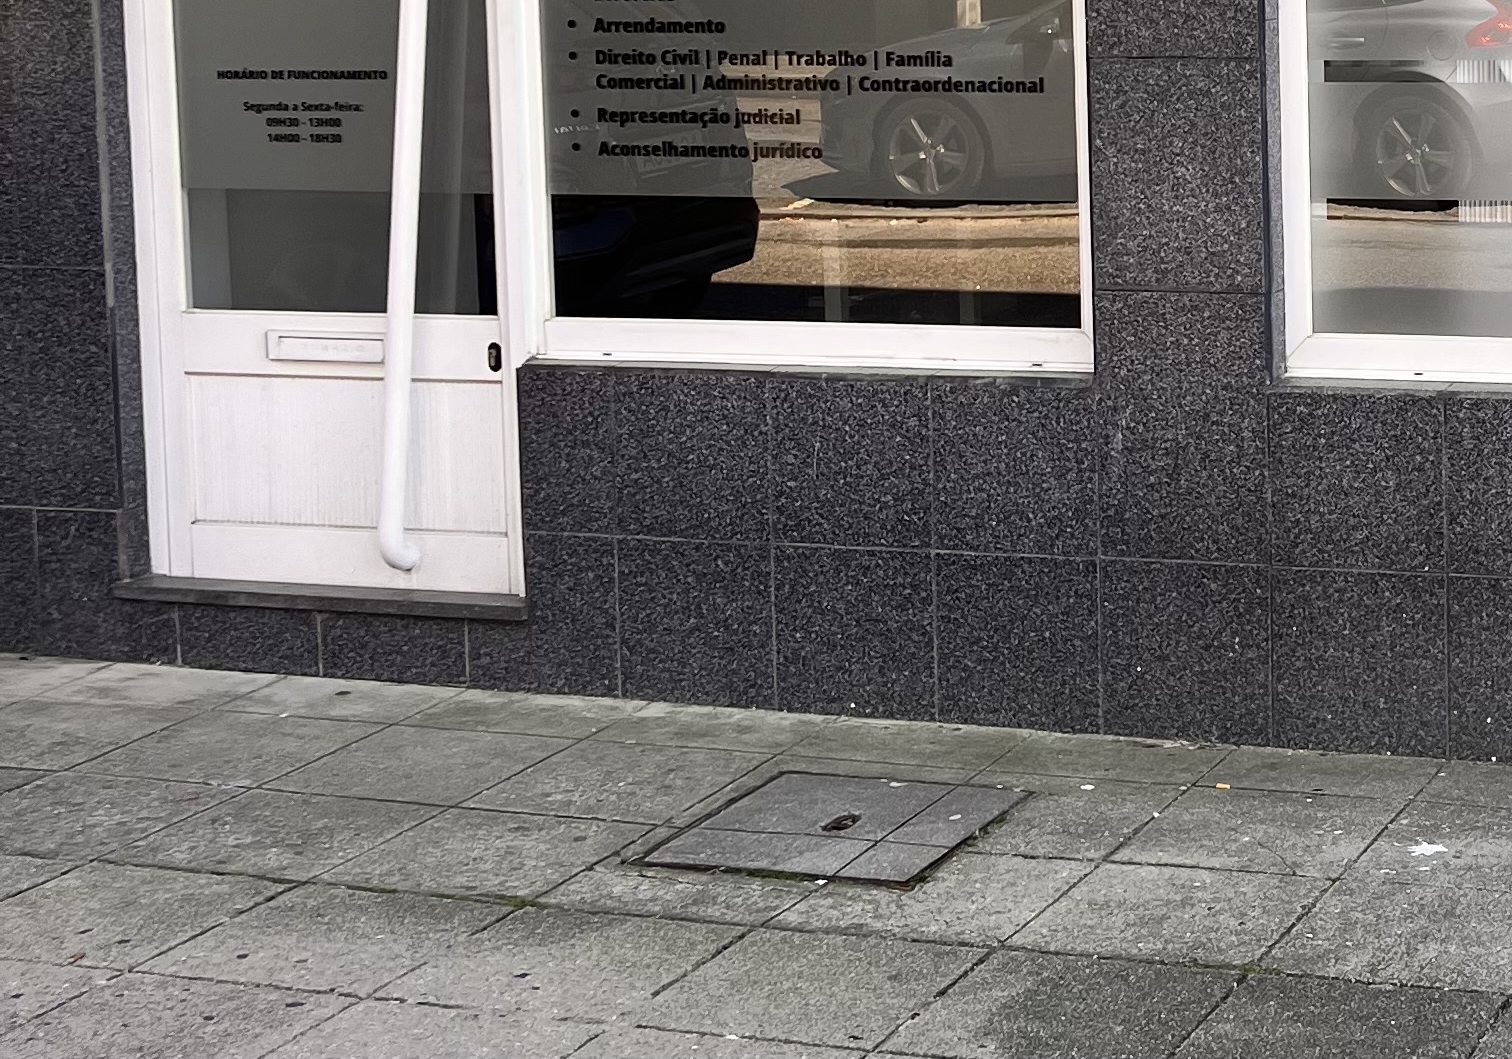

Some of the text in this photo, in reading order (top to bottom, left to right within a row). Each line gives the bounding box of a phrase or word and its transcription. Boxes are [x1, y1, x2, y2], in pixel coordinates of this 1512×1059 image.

[594, 18, 726, 34] Arrendamento
[594, 50, 656, 66] Direito
[660, 49, 699, 66] Civil
[718, 50, 767, 66] Penal
[785, 50, 867, 68] Trabalho
[886, 50, 953, 68] Família
[217, 67, 388, 80] HORÁRIO DE FUNCIONAMENTO
[596, 74, 685, 90] Comercial
[702, 74, 840, 92] Administrativo
[858, 76, 1044, 94] Contraordenacional
[243, 102, 289, 114] Segunda
[292, 104, 298, 112] a
[597, 107, 800, 128] Representação judicial
[598, 141, 749, 159] Aconselhamento
[752, 142, 823, 162] jurídico
